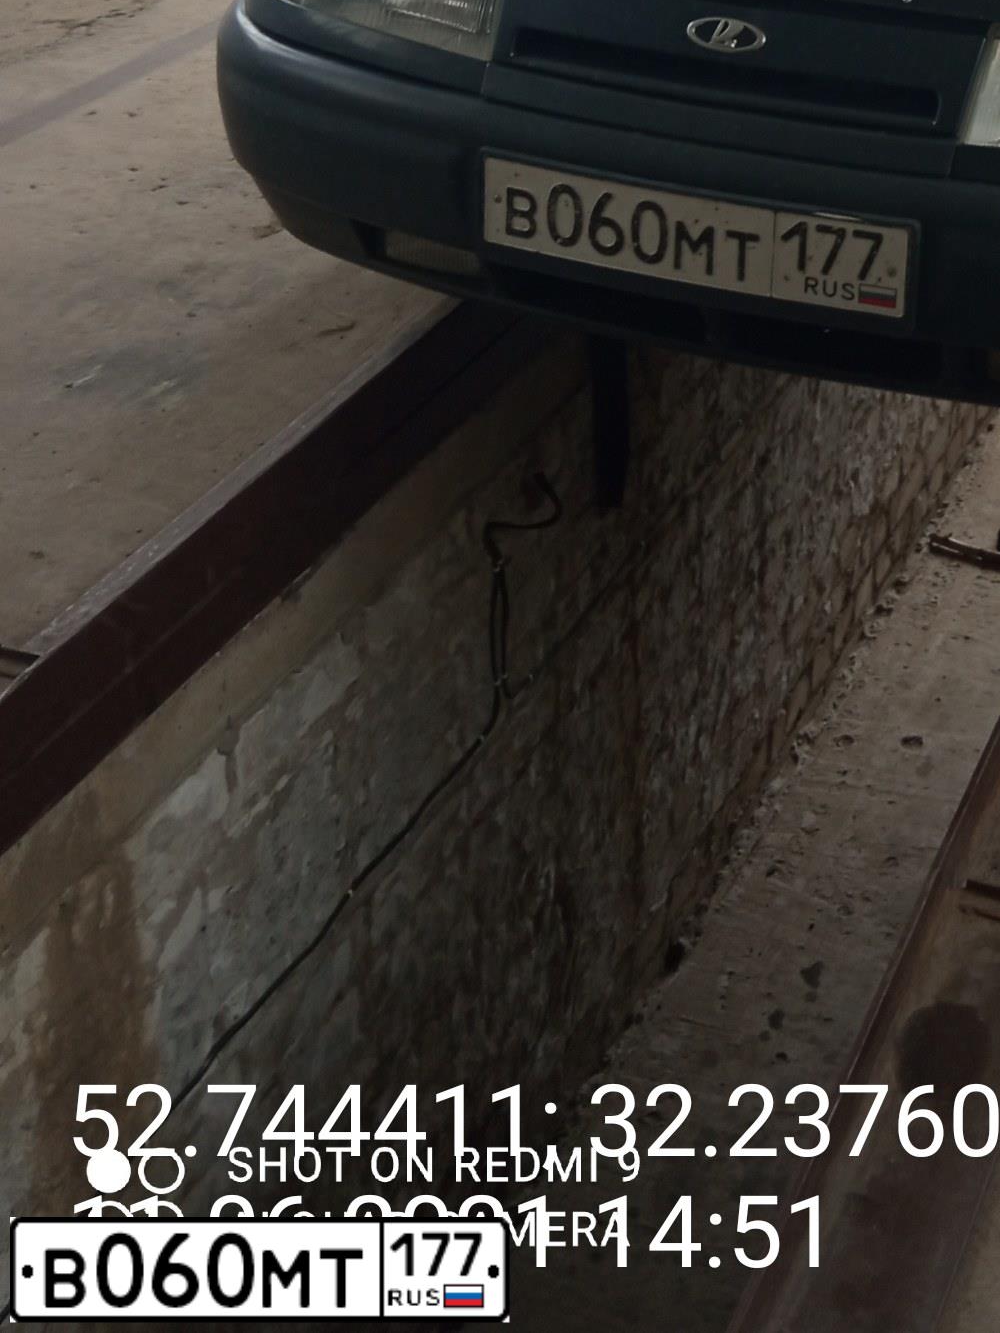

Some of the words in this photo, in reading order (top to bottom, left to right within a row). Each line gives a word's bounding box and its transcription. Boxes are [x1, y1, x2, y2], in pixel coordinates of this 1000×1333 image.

[505, 183, 761, 282] В060МТ
[780, 220, 884, 281] 177
[804, 275, 856, 302] RUS
